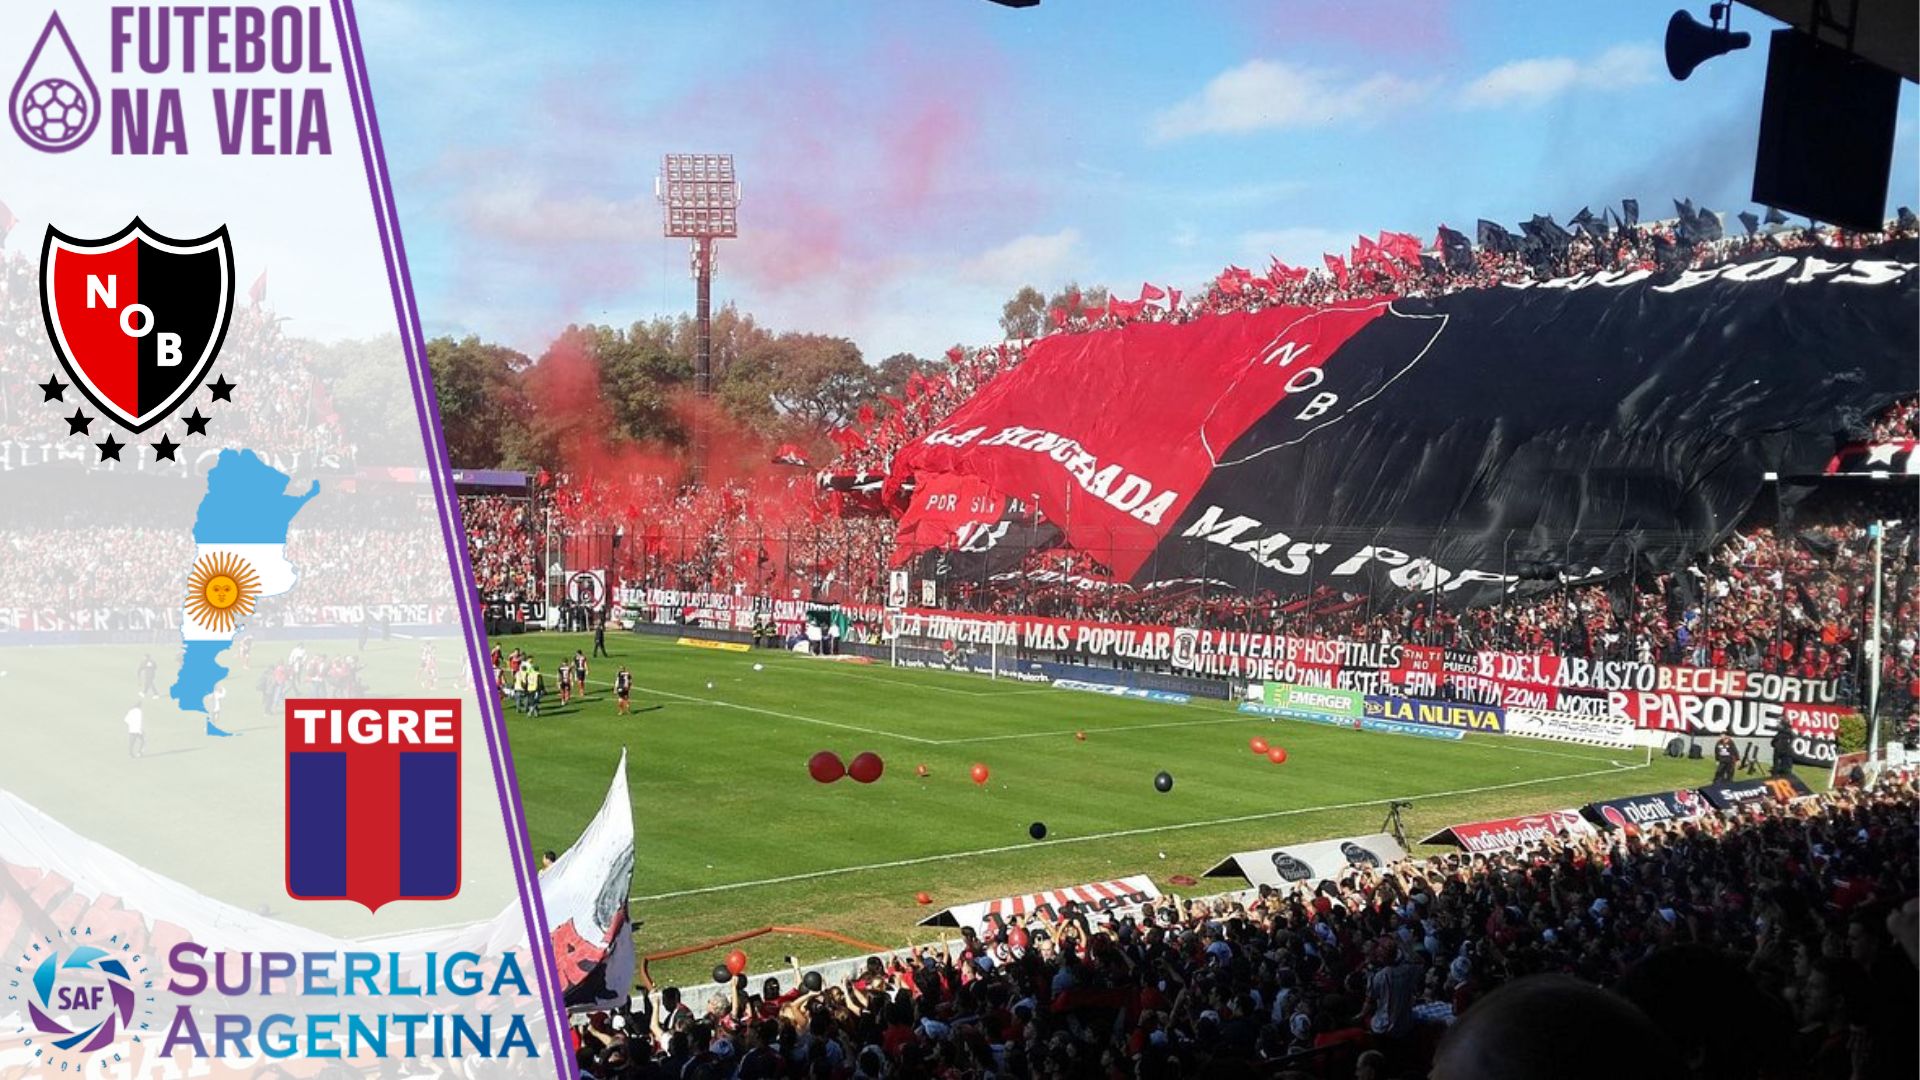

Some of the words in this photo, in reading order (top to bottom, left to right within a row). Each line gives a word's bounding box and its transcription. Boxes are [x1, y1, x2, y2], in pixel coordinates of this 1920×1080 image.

[926, 494, 957, 512] POR
[1181, 505, 1332, 576] MAS
[900, 613, 921, 636] LA
[927, 613, 1018, 646] HINCHADA
[1025, 622, 1071, 650] MAS
[1076, 626, 1171, 660] POPULAR
[1217, 631, 1285, 660] ALVEAR
[1194, 653, 1239, 677] VILLA
[1246, 657, 1297, 682] DIEGO
[1304, 639, 1404, 669] HOSPITALES
[1403, 650, 1424, 660] SIN
[1430, 651, 1441, 661] TI
[1412, 660, 1429, 670] NO
[1442, 662, 1478, 674] PUEDO
[1336, 669, 1379, 697] OESTE
[1404, 671, 1438, 697] SAN
[1498, 653, 1550, 685] DEL
[1552, 657, 1656, 692] ABASTO
[1289, 690, 1353, 710] EMERGER
[1503, 687, 1548, 710] ZONA
[1384, 701, 1415, 721] LA
[1418, 704, 1501, 730] NUEVA
[1639, 693, 1784, 736] PARQUE
[1624, 797, 1674, 823] plenit
